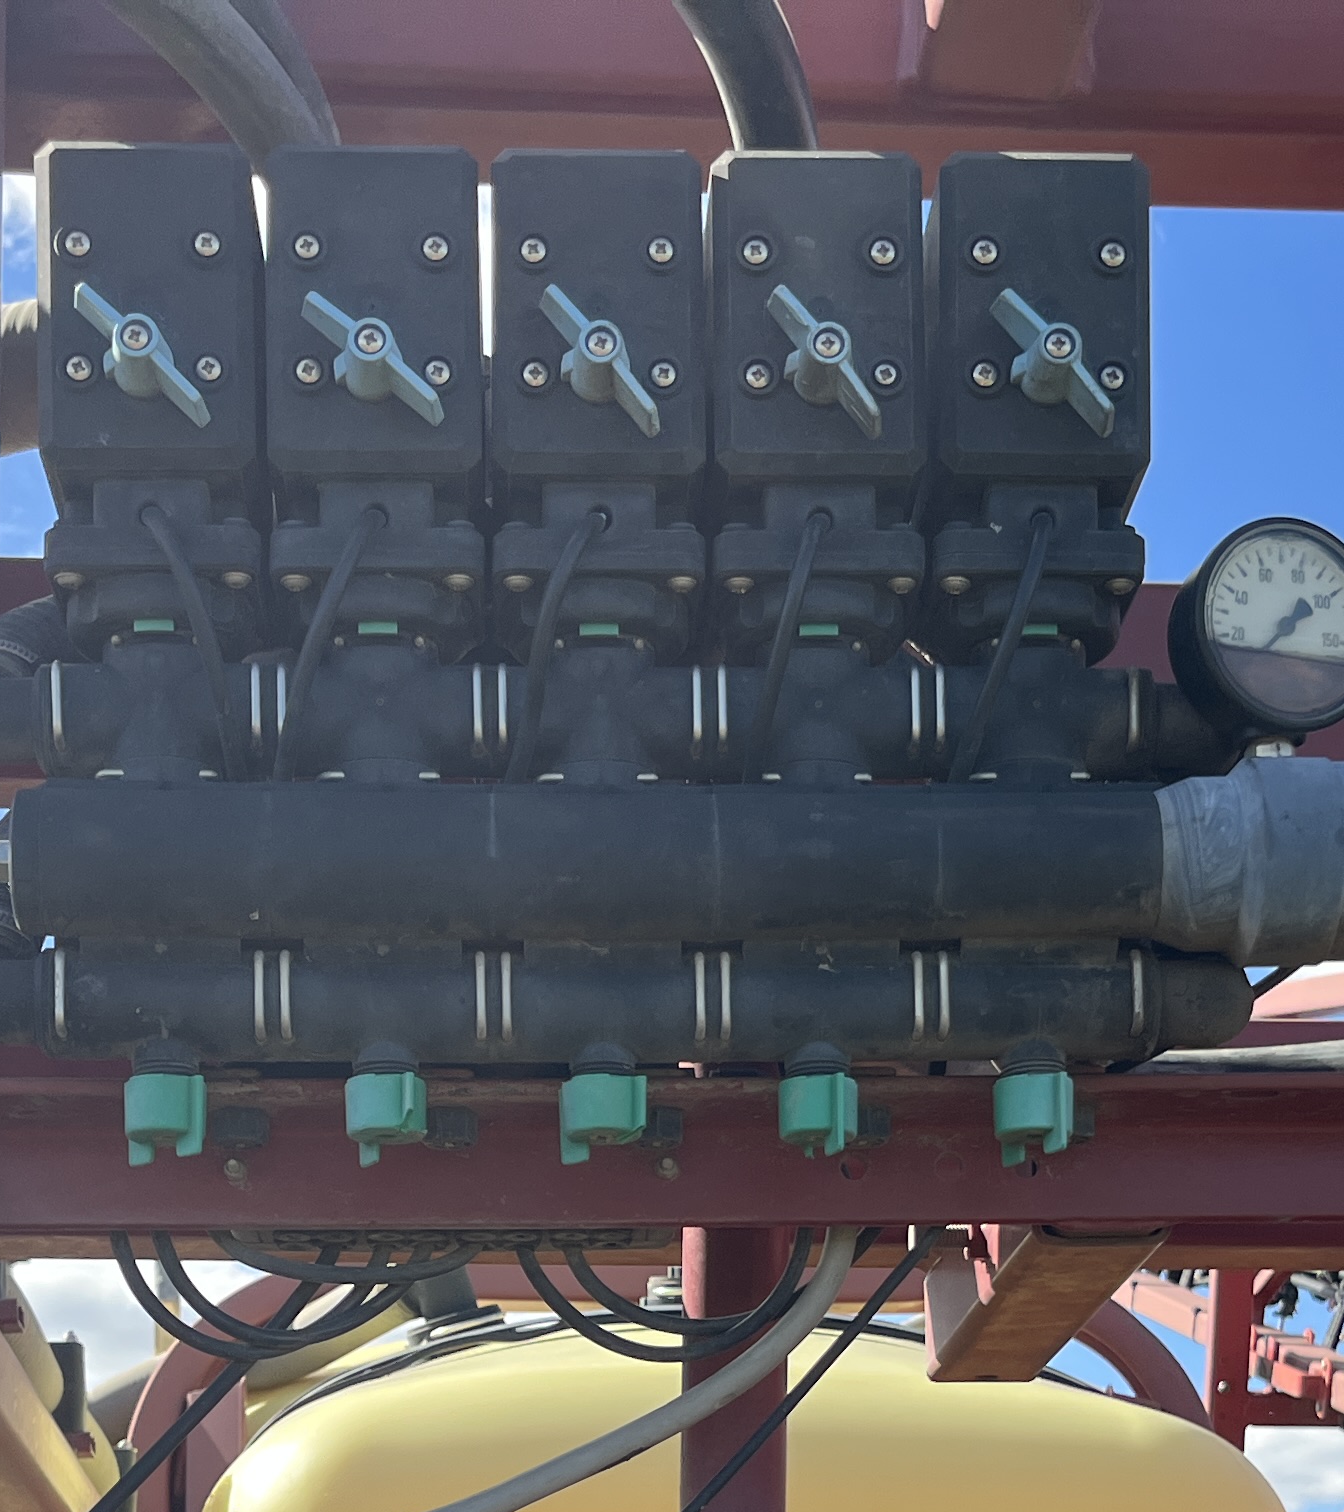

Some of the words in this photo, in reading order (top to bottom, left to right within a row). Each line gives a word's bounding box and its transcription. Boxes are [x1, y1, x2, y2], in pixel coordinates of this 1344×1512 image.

[1258, 569, 1273, 583] 60
[1291, 569, 1306, 584] 80
[1234, 590, 1249, 606] 40
[1313, 594, 1331, 610] 100
[1231, 626, 1246, 641] 20
[1321, 632, 1340, 648] 150
